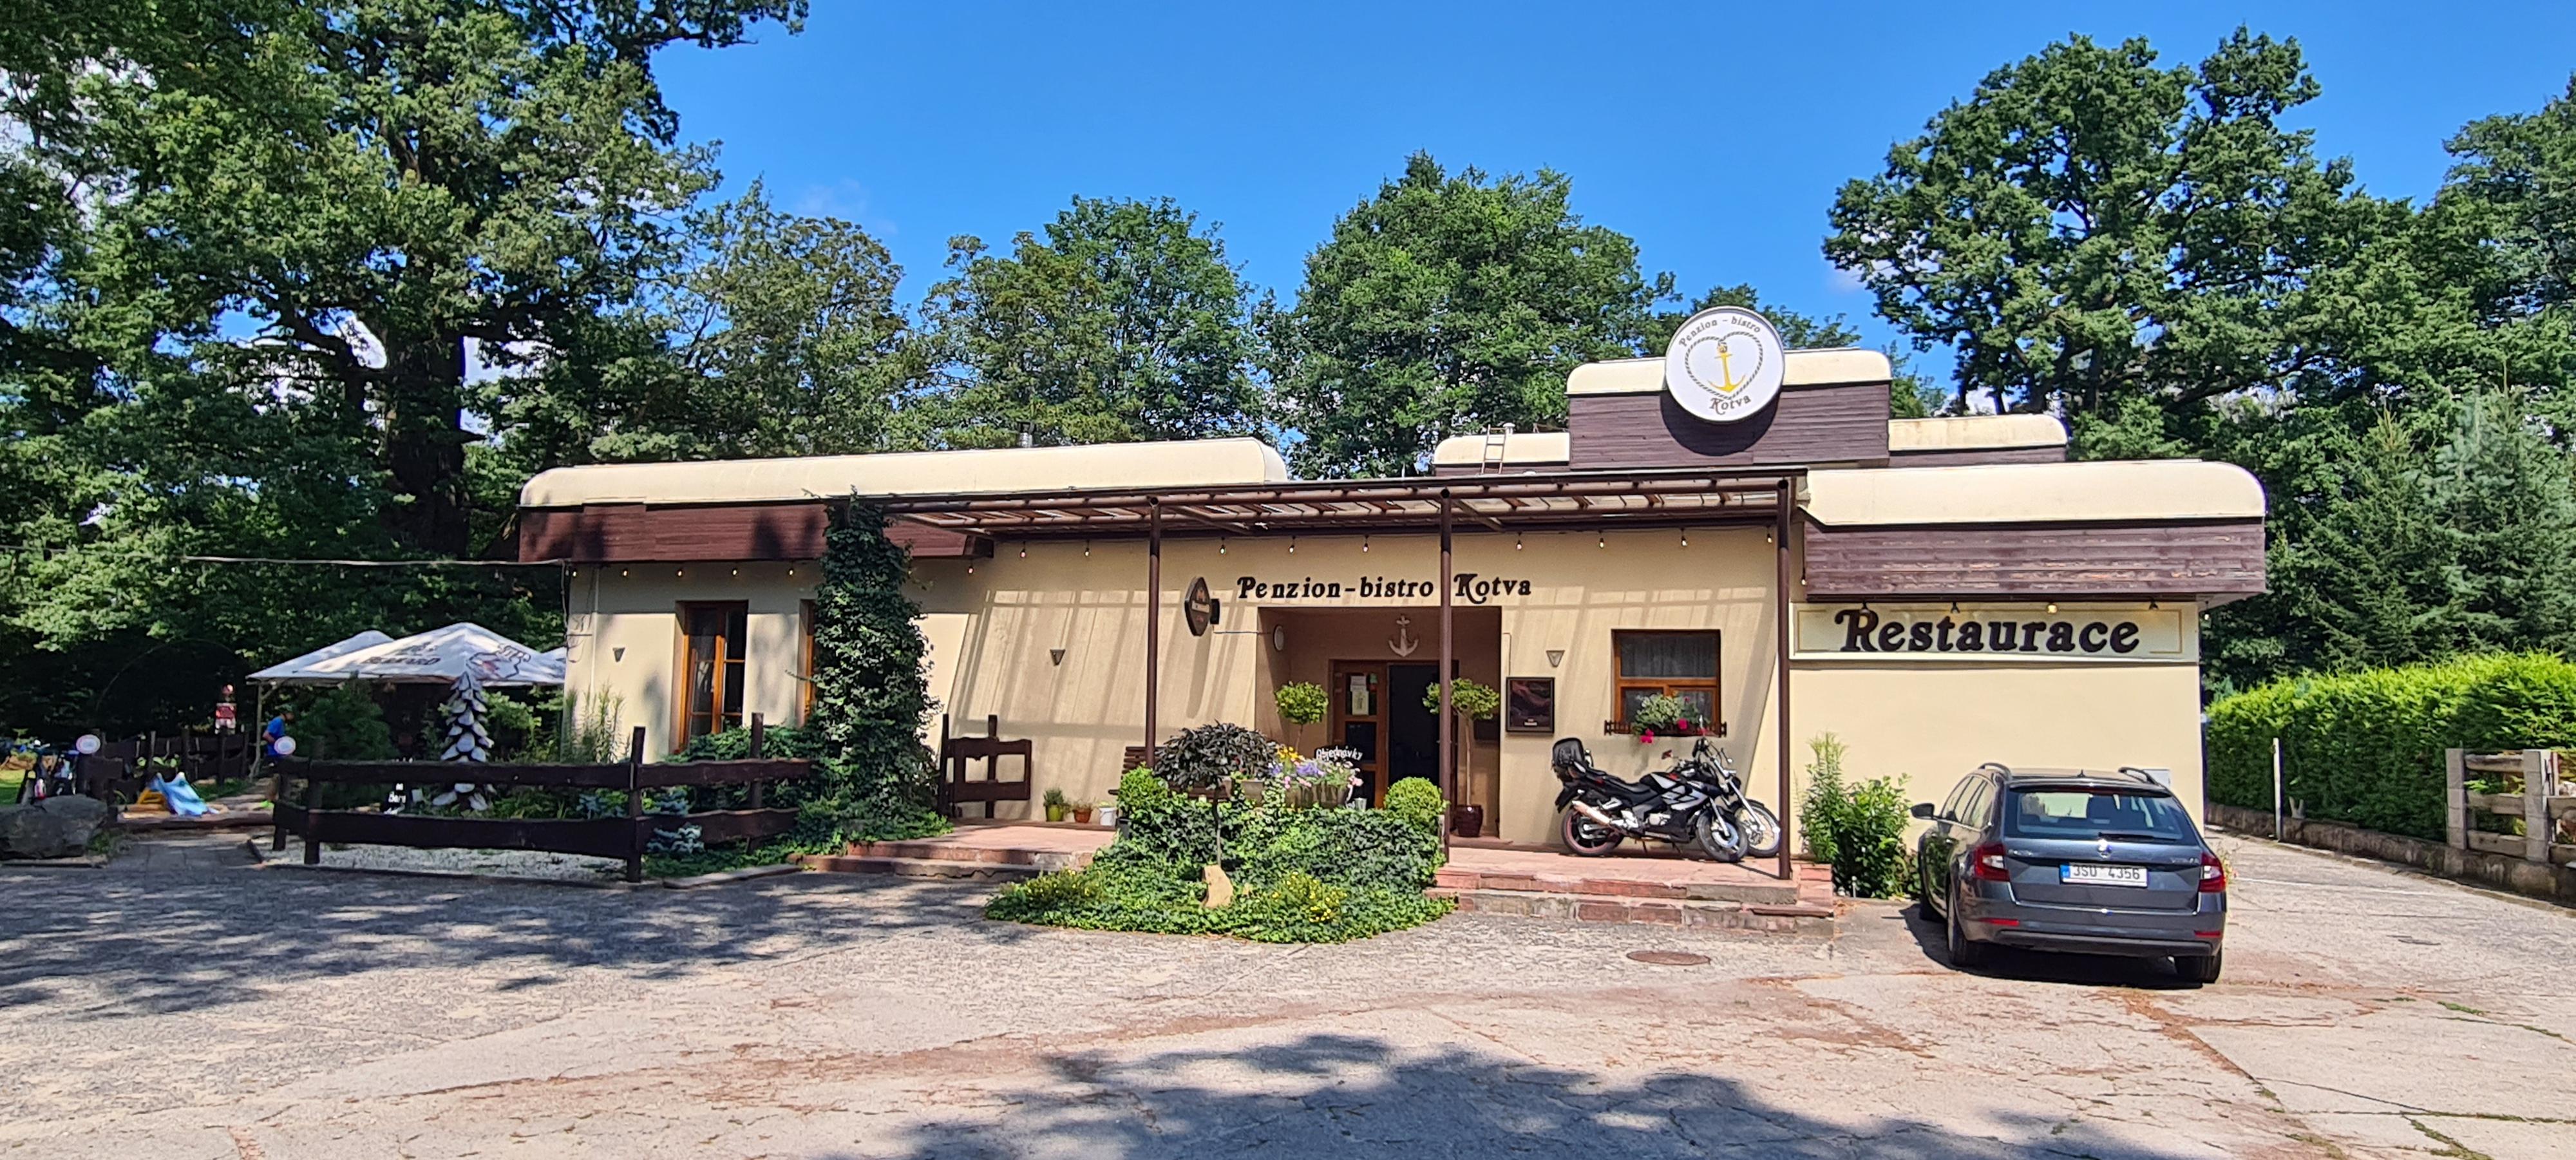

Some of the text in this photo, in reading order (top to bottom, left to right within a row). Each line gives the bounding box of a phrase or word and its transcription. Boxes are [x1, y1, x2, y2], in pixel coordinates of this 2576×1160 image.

[1679, 319, 1718, 347] Penzion
[1731, 316, 1761, 333] bistro
[1709, 395, 1751, 415] Kotva
[1454, 573, 1531, 604] Kotva
[1835, 609, 2139, 654] Restaurace
[2108, 866, 2140, 880] 4356
